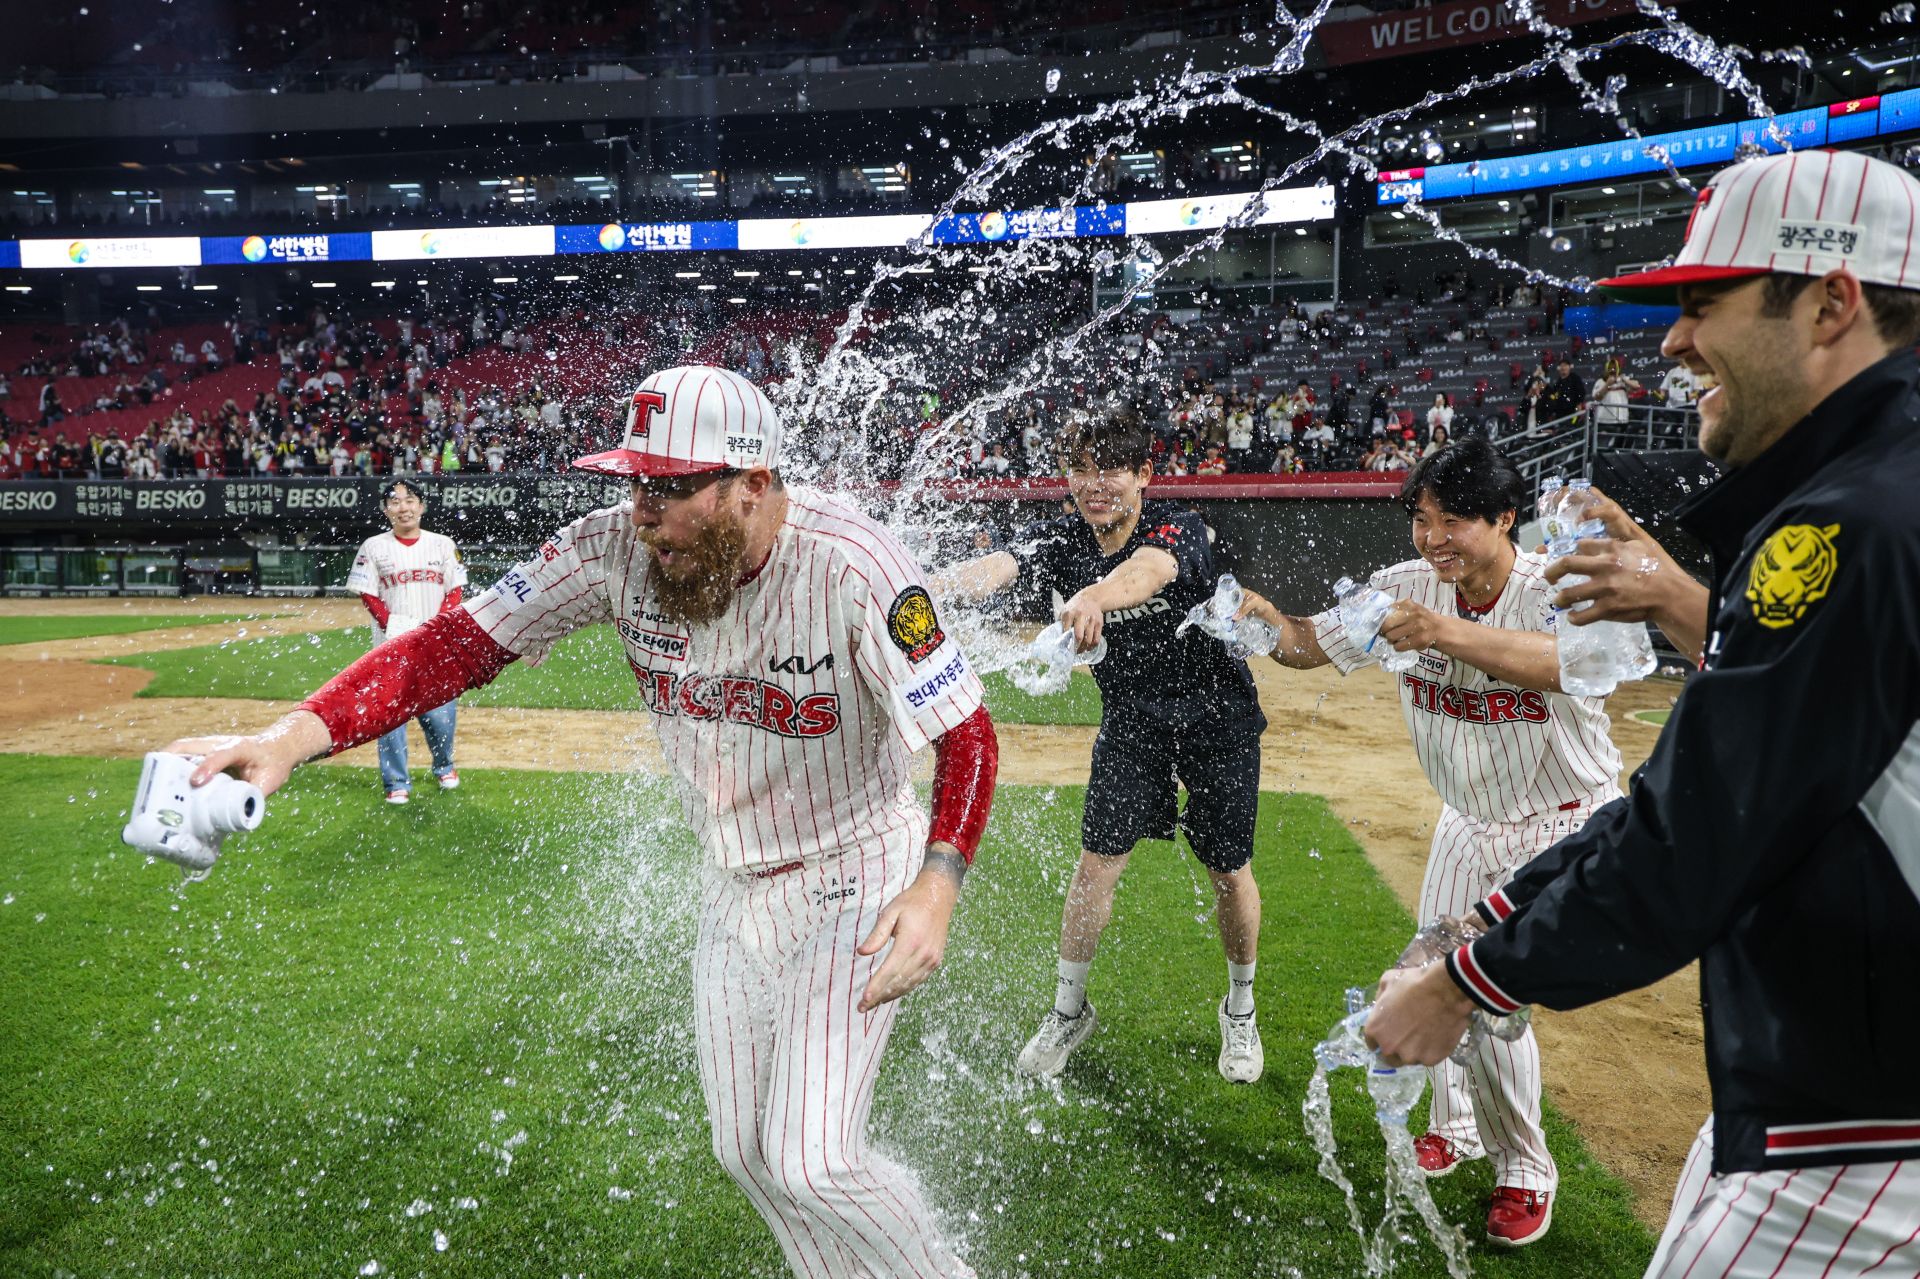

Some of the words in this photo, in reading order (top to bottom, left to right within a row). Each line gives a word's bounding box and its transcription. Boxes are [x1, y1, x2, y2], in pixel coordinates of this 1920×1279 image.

[1371, 1, 1546, 49] WELCOM
[1846, 102, 1860, 112] SP
[1500, 167, 1510, 179] 2
[1520, 164, 1530, 177] 3
[1539, 161, 1550, 174] 4
[1560, 159, 1570, 171] 5
[1580, 154, 1592, 167] 6
[1602, 151, 1613, 165] 7
[1621, 149, 1634, 162] 8
[1685, 138, 1704, 152] 11
[1707, 134, 1728, 149] 12
[626, 223, 693, 246] 선한병원
[1778, 225, 1858, 255] 광주은행
[268, 235, 330, 257] 선한병원
[631, 390, 666, 438] T
[726, 435, 764, 455] 광주은행
[0, 491, 57, 511] ESKO
[75, 485, 134, 500] 유압기기는
[136, 489, 207, 510] BESKO
[225, 484, 284, 499] 유압기기는
[286, 488, 359, 509] BESKO
[442, 486, 517, 509] BESKO
[380, 569, 445, 589] TIGERS
[620, 621, 685, 657] 금호타이어
[1402, 671, 1550, 725] TIGERS
